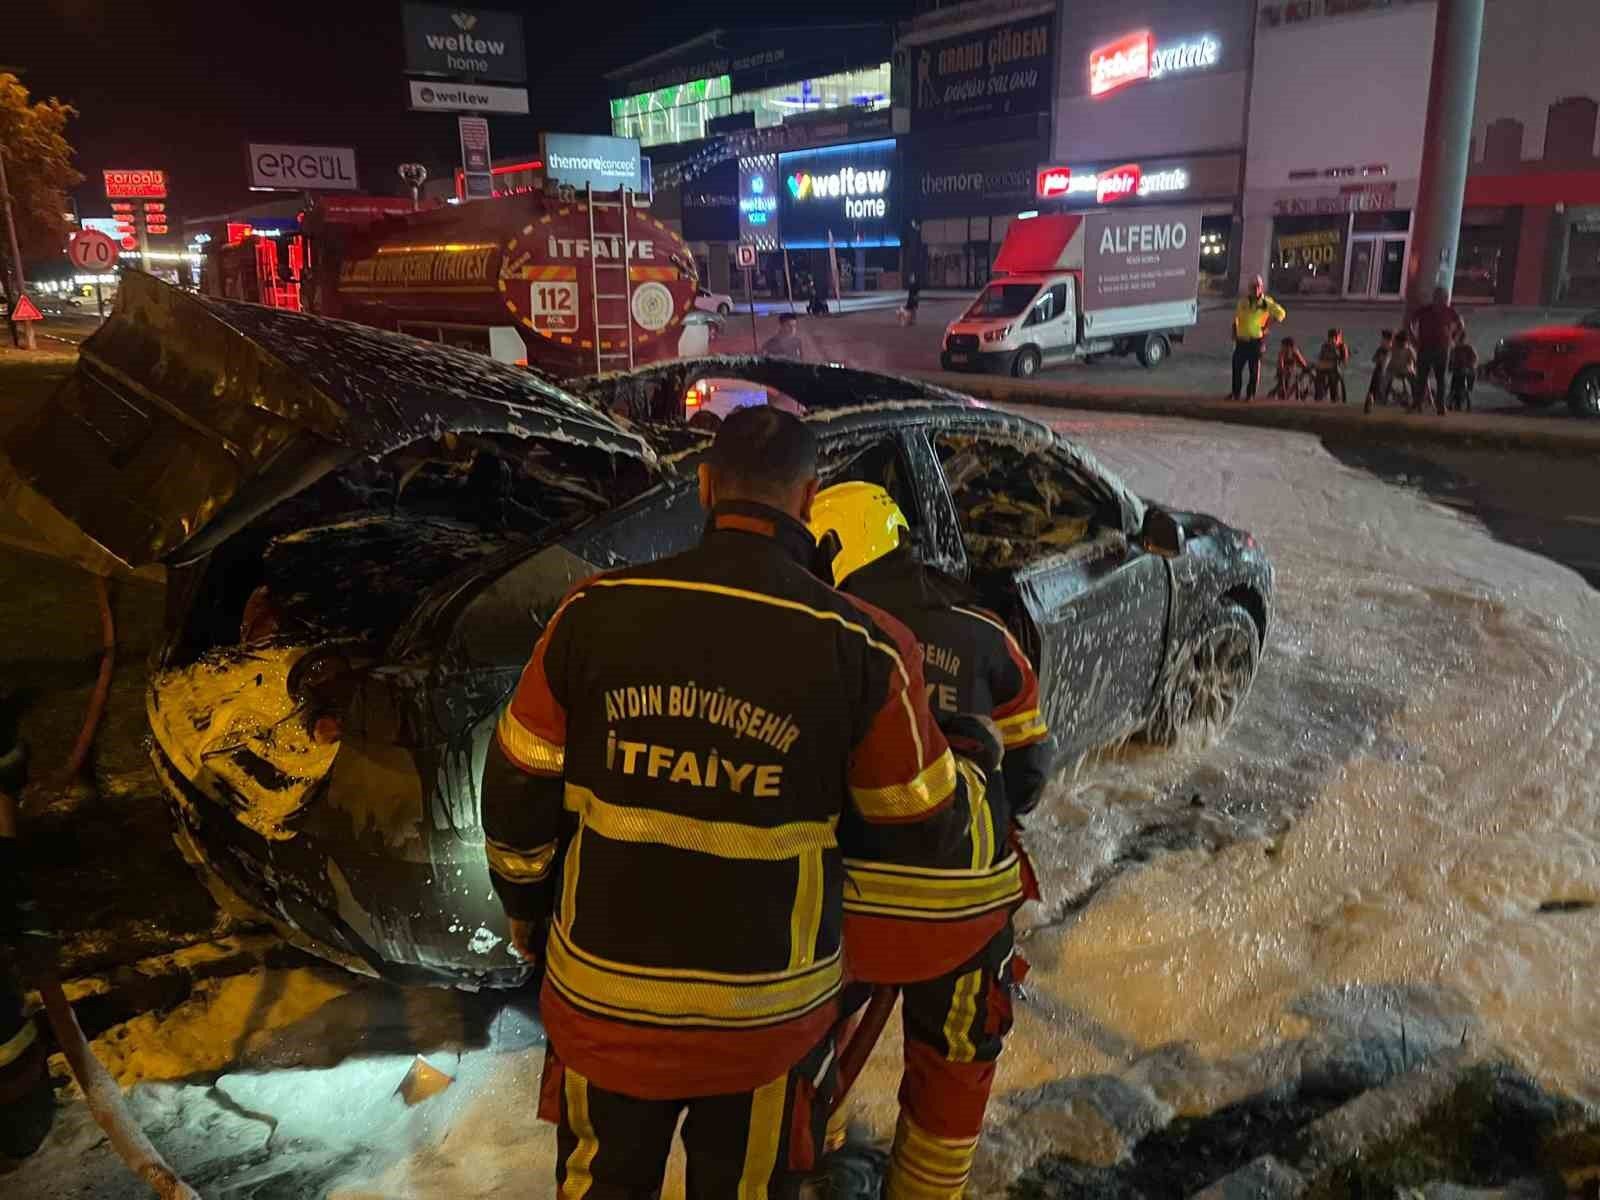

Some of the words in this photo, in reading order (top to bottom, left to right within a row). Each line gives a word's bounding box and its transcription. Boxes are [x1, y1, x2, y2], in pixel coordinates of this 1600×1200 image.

[425, 33, 505, 56] weltew
[448, 53, 489, 72] home
[436, 91, 489, 105] weltew
[811, 166, 887, 198] weltew
[846, 196, 886, 219] home
[547, 235, 655, 260] İTFAİYE
[1098, 222, 1187, 256] ALFEMO
[79, 242, 109, 262] 70
[742, 247, 752, 260] D
[539, 288, 572, 310] 112
[605, 684, 662, 722] AYDIN
[668, 680, 800, 754] BÜYÜKŞEHİR
[606, 729, 783, 798] İTFAİYE
